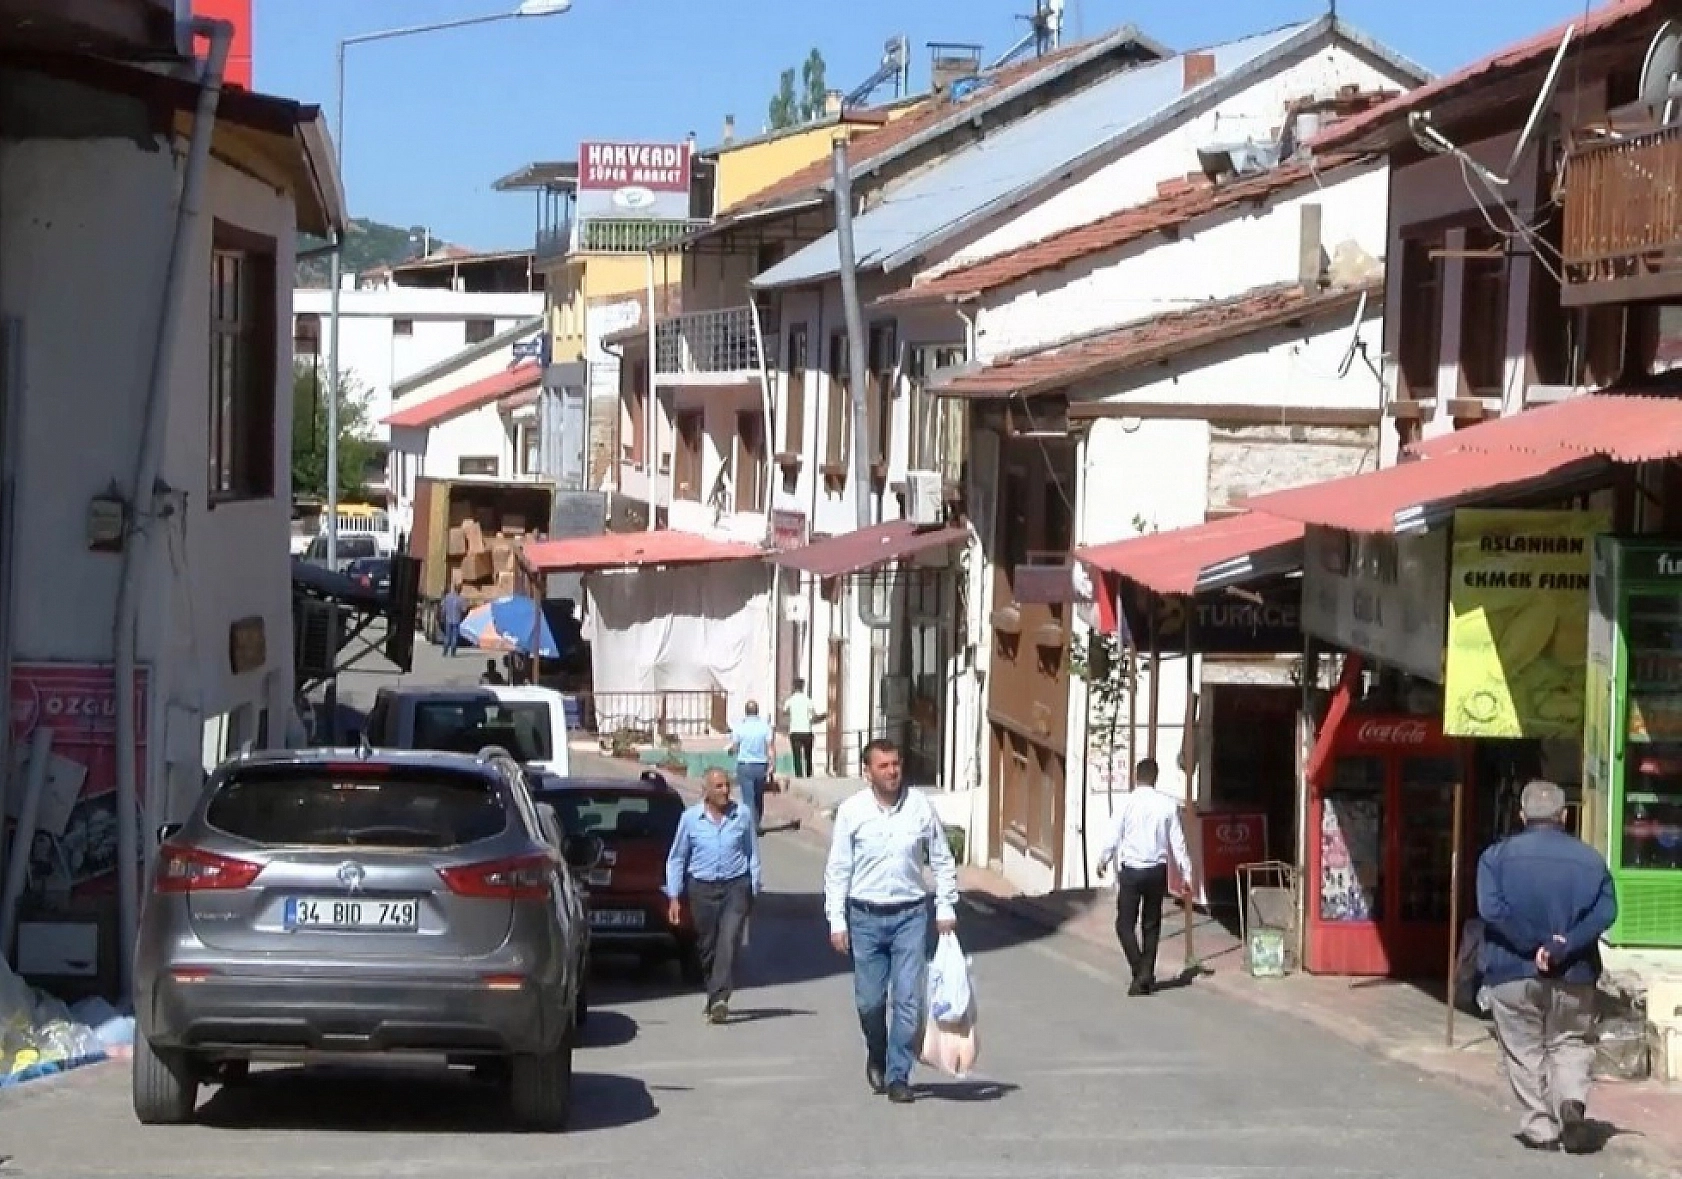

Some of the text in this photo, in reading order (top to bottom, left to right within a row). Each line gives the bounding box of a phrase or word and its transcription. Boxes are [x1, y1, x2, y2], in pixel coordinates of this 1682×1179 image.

[588, 165, 681, 184] SÜPER MARKET
[1480, 535, 1585, 555] ASLANHAN
[1463, 571, 1533, 589] EKMEK
[1196, 604, 1299, 628] TURKCE
[299, 901, 320, 923] 34
[379, 903, 413, 925] 749
